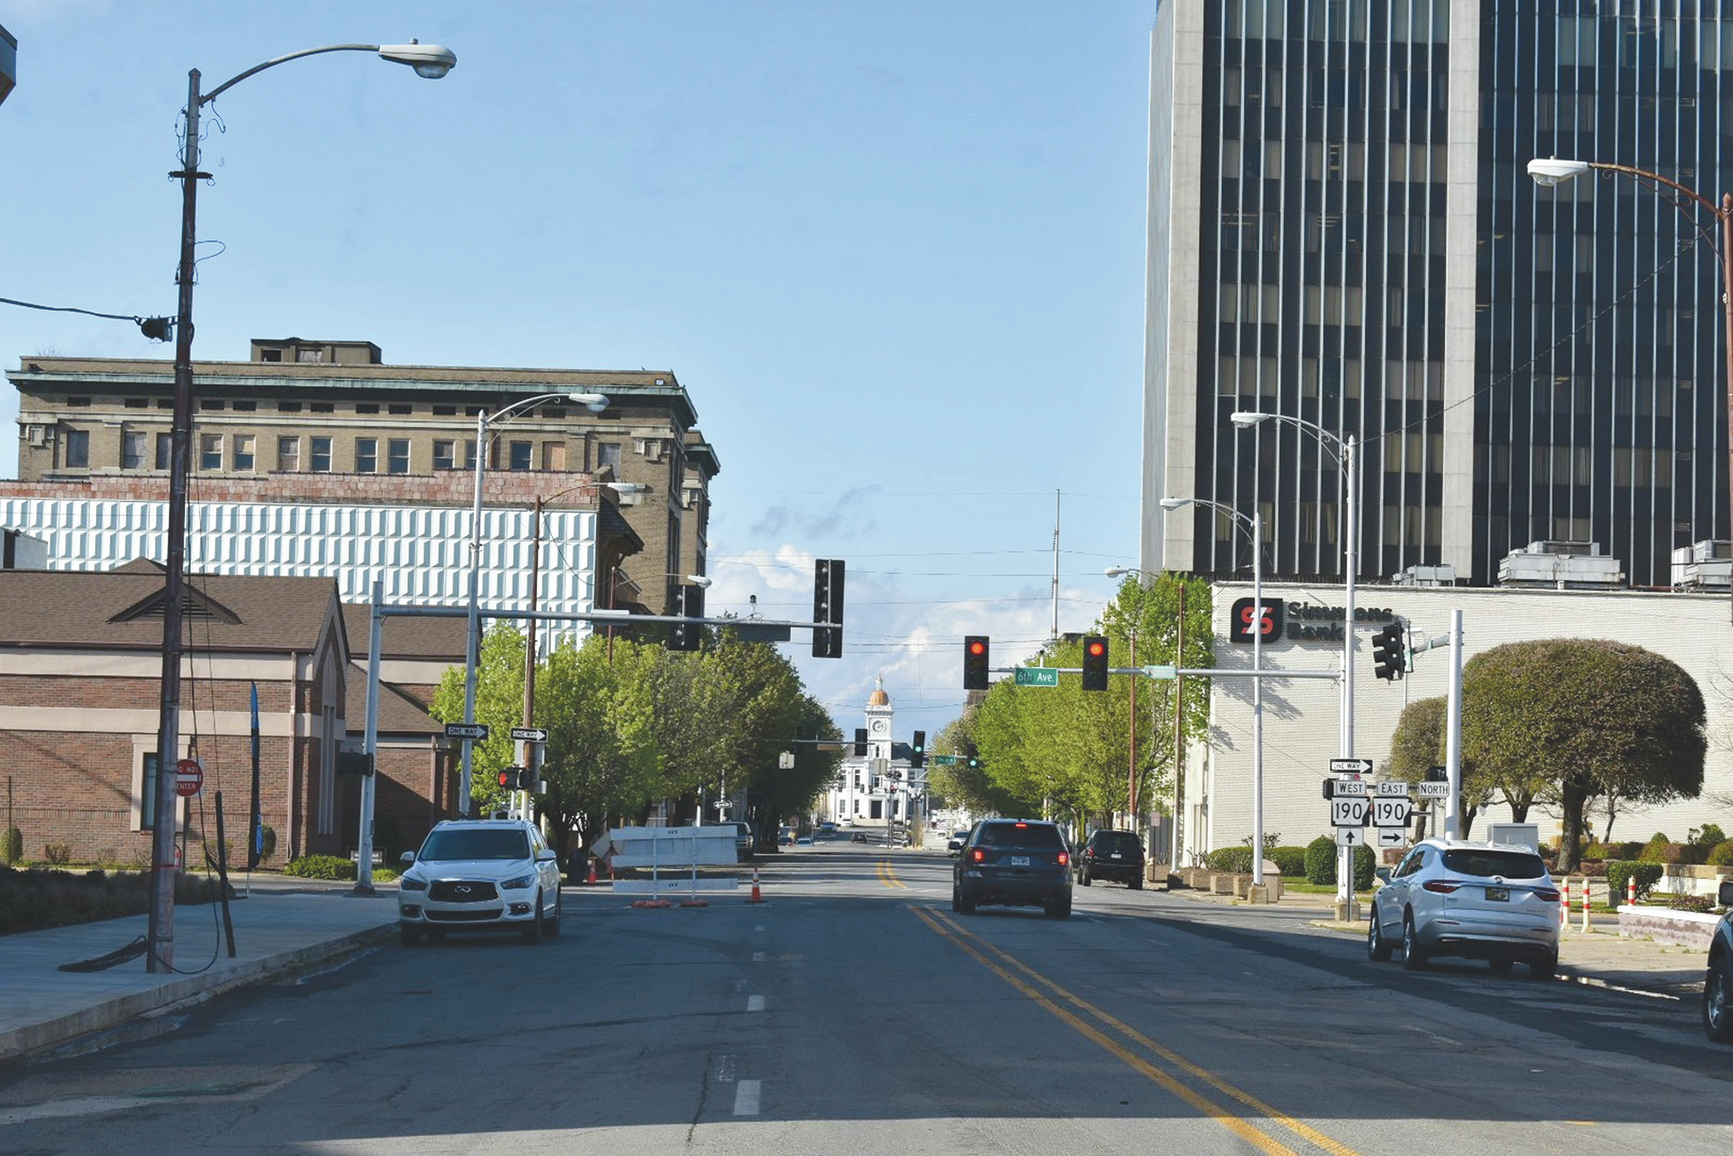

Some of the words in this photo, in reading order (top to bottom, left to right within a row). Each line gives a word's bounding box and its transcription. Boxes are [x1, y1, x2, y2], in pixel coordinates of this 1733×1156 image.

[1287, 601, 1393, 621] Simmons
[1286, 622, 1344, 641] Bank
[1017, 671, 1033, 682] 6th
[1333, 762, 1345, 770] ONE
[176, 782, 197, 790] ENTER
[1339, 783, 1363, 793] WEST
[1381, 783, 1403, 794] EAST
[1420, 784, 1447, 795] NORTH
[1335, 803, 1362, 820] 190
[1377, 803, 1404, 821] 190
